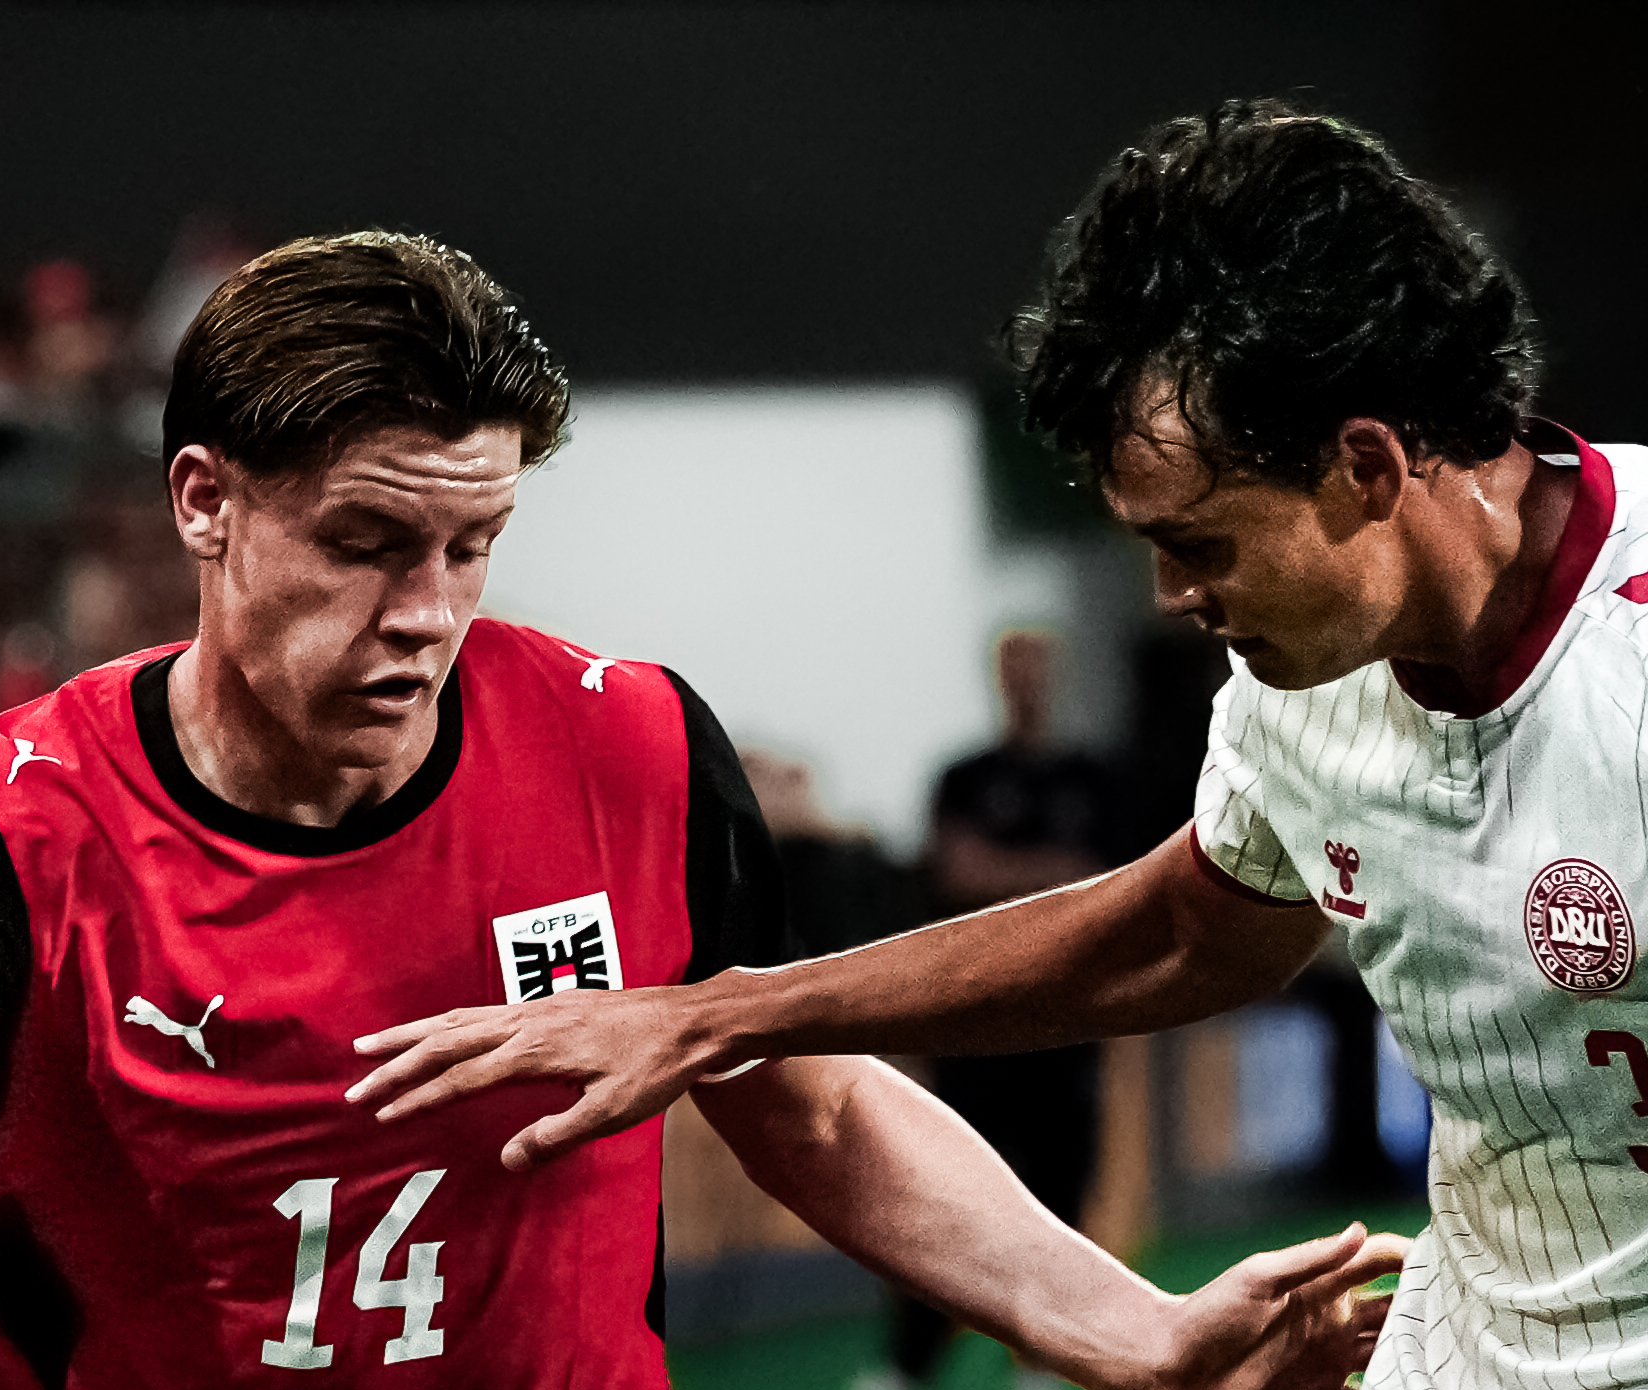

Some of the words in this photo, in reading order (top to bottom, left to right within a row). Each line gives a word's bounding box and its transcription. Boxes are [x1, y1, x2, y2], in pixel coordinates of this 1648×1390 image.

[1548, 906, 1611, 948] DBU
[1608, 910, 1629, 976] UNION
[1564, 971, 1610, 988] 1889
[261, 1168, 448, 1369] 14
